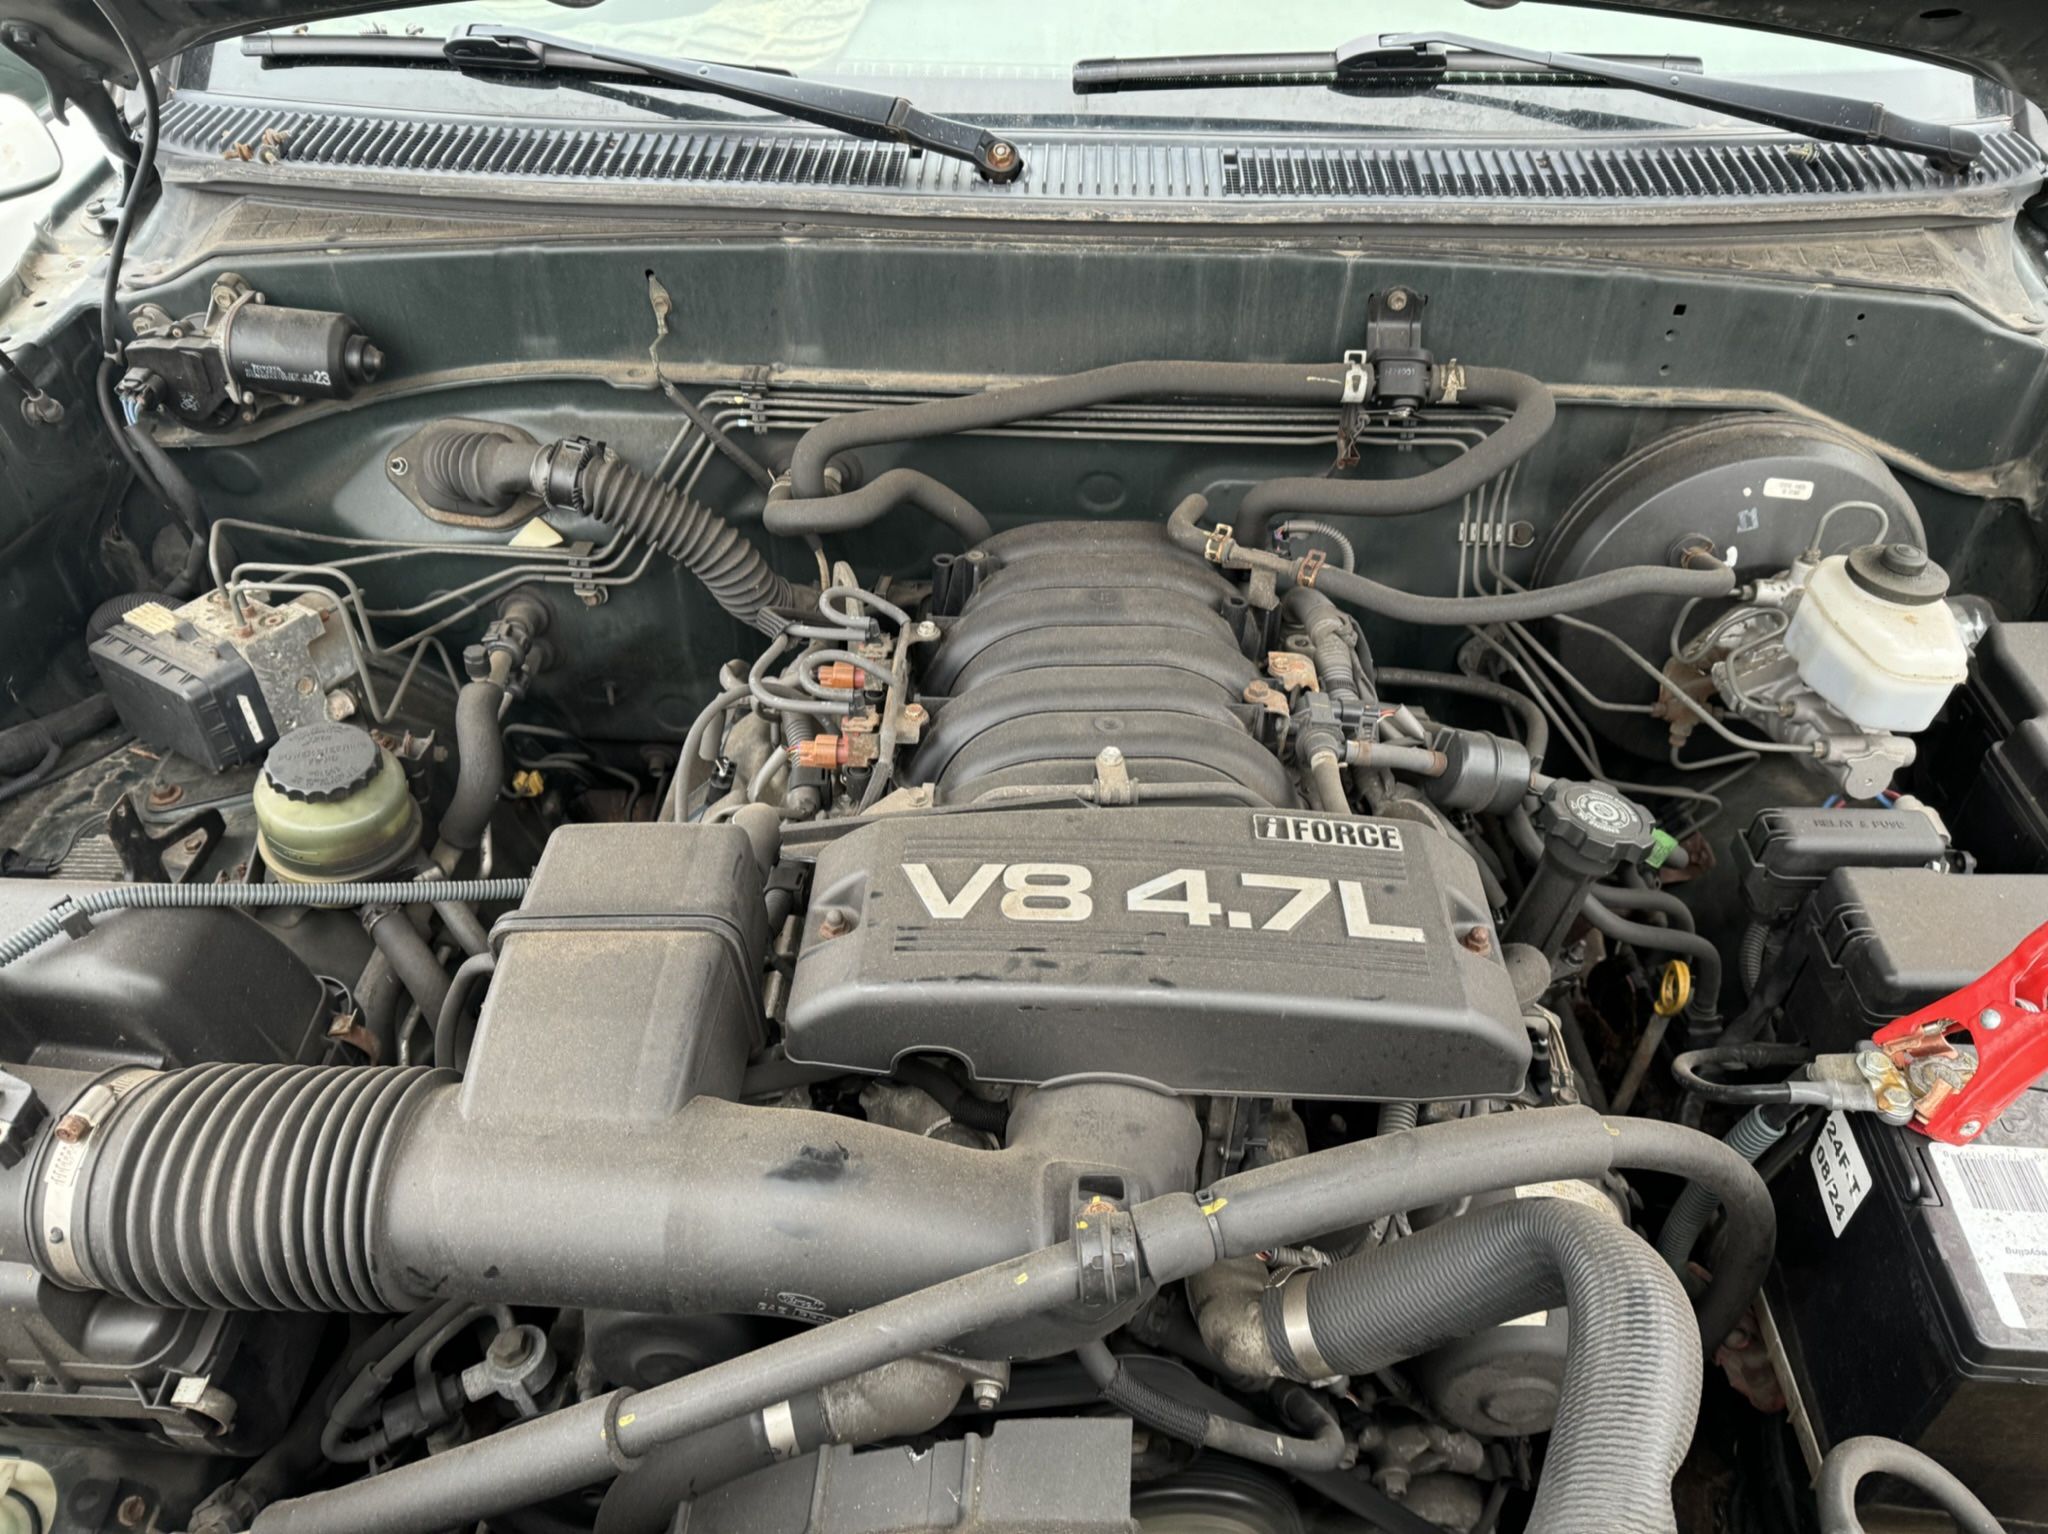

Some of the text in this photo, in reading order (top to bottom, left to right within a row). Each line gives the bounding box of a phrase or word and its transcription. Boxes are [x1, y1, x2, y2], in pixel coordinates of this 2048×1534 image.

[900, 862, 1426, 943] V8 4.7L
[1815, 1145, 1846, 1222] 08/24
[1825, 1120, 1861, 1198] 24F-T
[2004, 1246, 2048, 1258] ecycling
